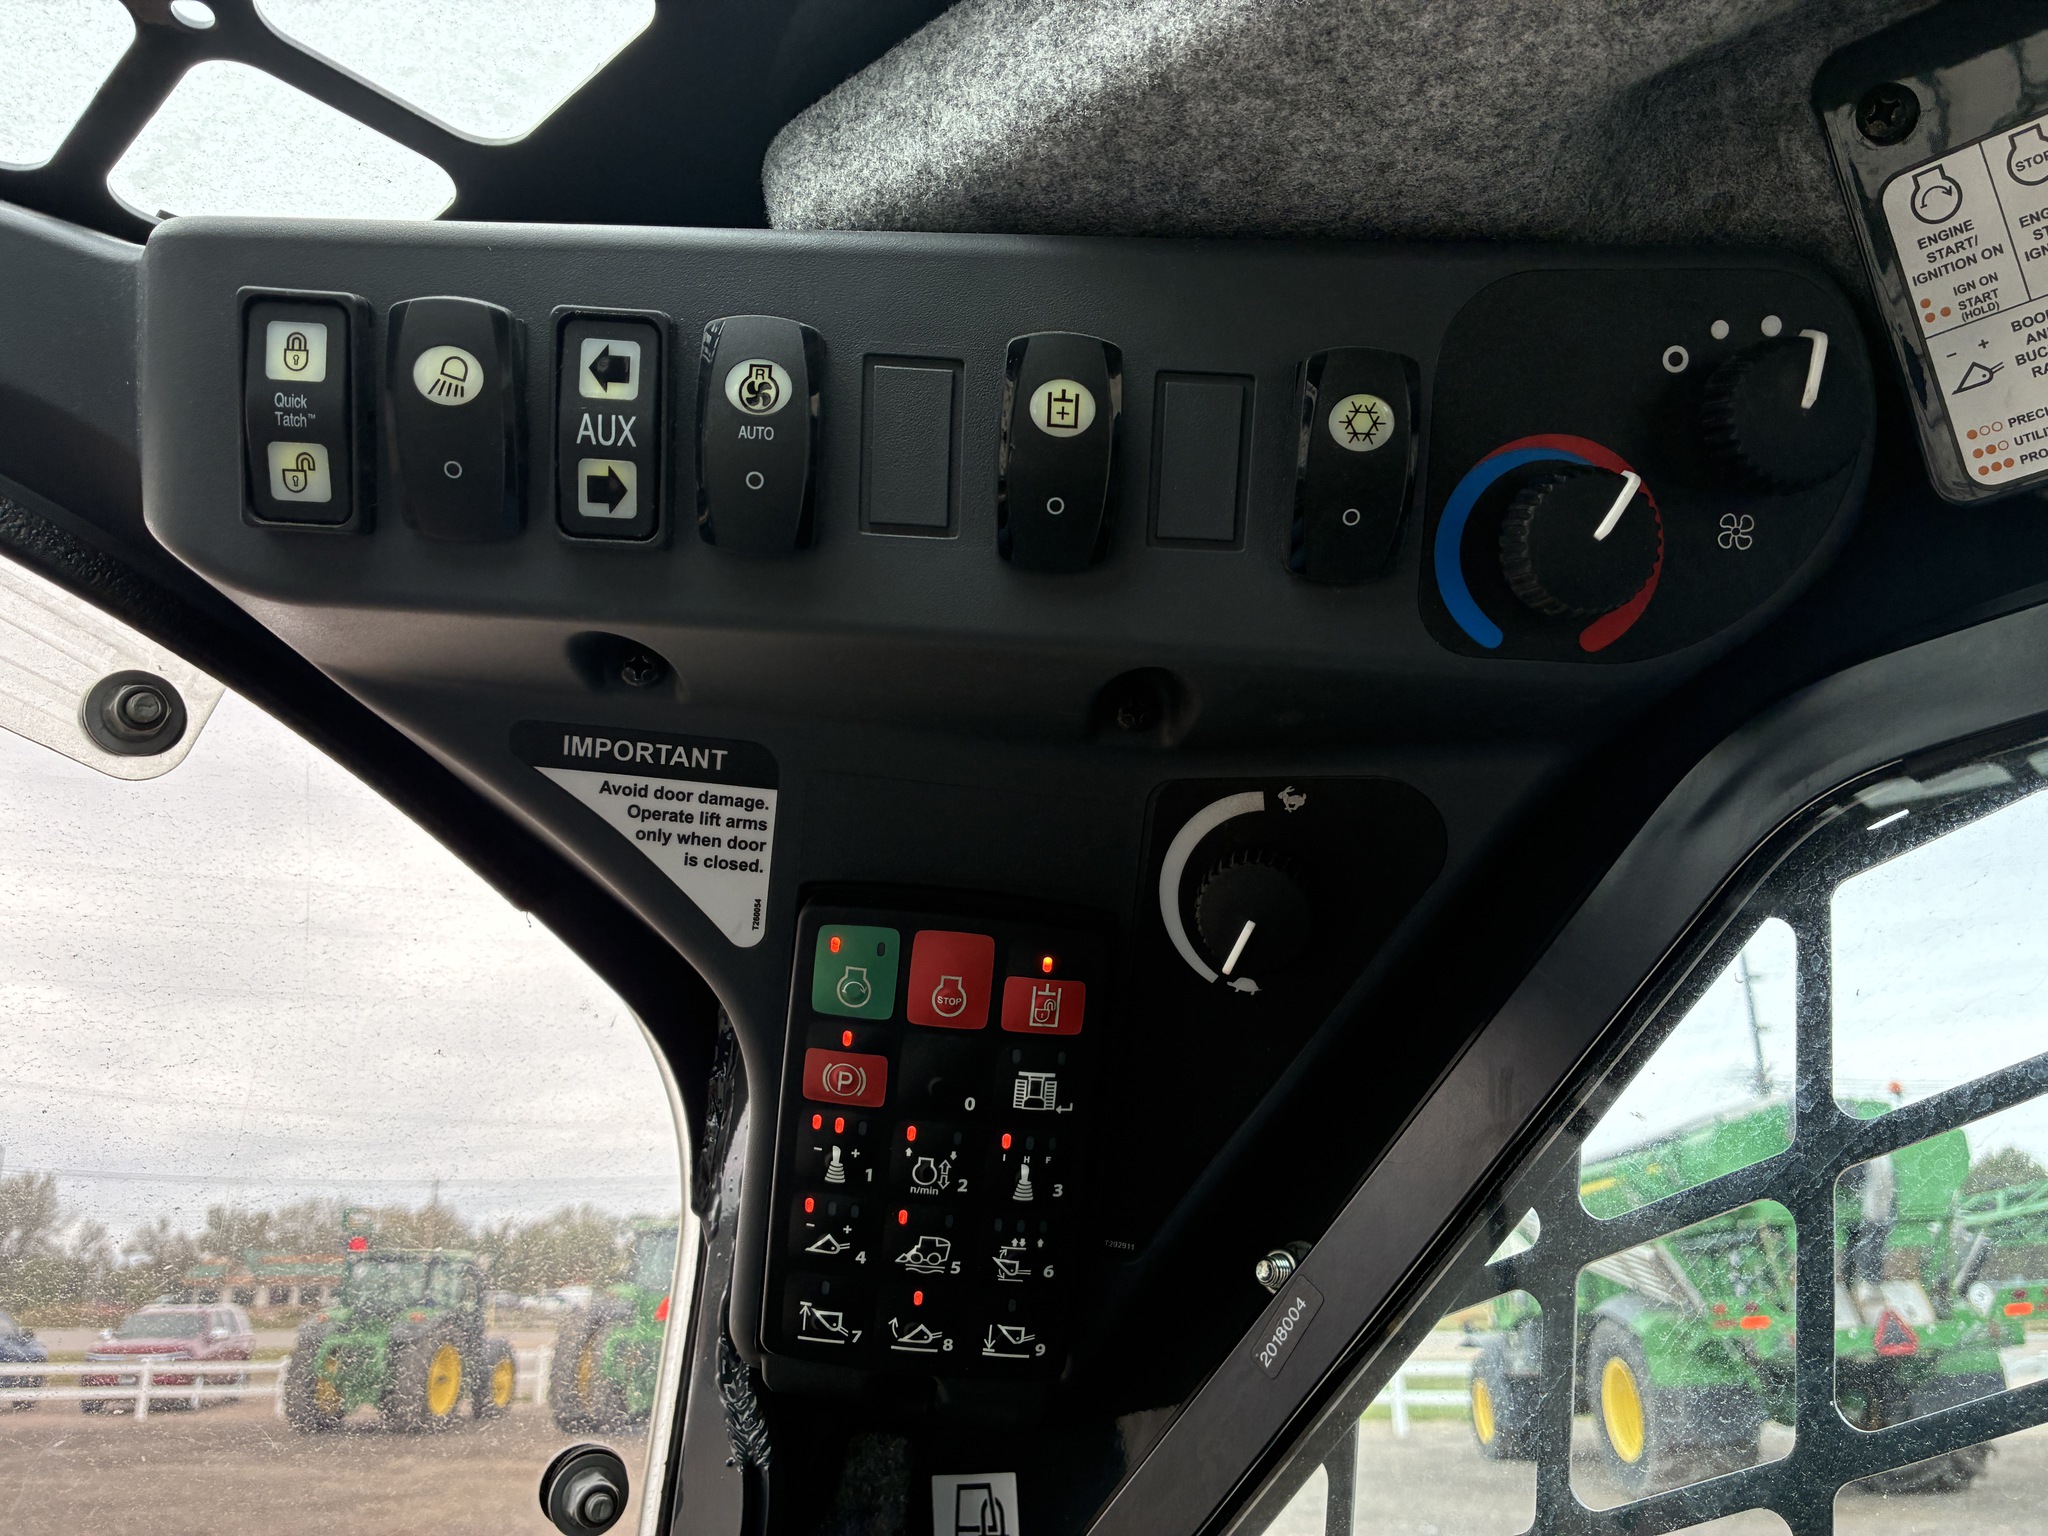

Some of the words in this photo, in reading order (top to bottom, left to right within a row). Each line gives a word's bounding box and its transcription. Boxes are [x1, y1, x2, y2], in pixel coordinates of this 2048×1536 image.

[1917, 219, 1975, 250] ENGINE
[1926, 234, 1979, 263] START/
[1912, 253, 1978, 287] IGNITION
[1980, 243, 2004, 261] ON
[1953, 280, 1977, 296] IGN
[1978, 271, 1999, 286] ON
[1958, 288, 1999, 311] START
[1961, 301, 2000, 322] (HOLD)
[2010, 309, 2048, 333] BOO
[2026, 327, 2048, 346] AN
[755, 368, 765, 380] R
[274, 392, 308, 409] Quick
[576, 414, 637, 448] AUX
[738, 425, 775, 441] AUTO
[2014, 427, 2048, 446] UTILI
[563, 734, 728, 770] IMPORTANT
[599, 780, 648, 798] Avoid
[653, 786, 694, 803] door
[698, 790, 769, 812] damage.
[627, 804, 694, 824] Operate
[699, 811, 721, 827] lift
[725, 816, 768, 831] arms
[635, 828, 672, 846] only
[677, 832, 721, 848] when
[727, 836, 767, 852] door
[684, 852, 698, 867] is
[703, 855, 764, 873] closed.
[752, 898, 762, 931] T260054
[937, 995, 962, 1006] STOP
[837, 1071, 853, 1092] P
[964, 1097, 976, 1112] 0
[1045, 1156, 1052, 1164] F
[865, 1168, 873, 1182] 1
[909, 1184, 939, 1196] n/min
[957, 1179, 968, 1193] 2
[1052, 1183, 1063, 1197] 3
[855, 1251, 867, 1264] 4
[950, 1261, 961, 1274] 5
[1043, 1265, 1054, 1278] 6
[852, 1330, 863, 1343] 7
[1260, 1297, 1306, 1368] 2018004
[942, 1339, 953, 1352] 8
[1035, 1343, 1046, 1356] 9
